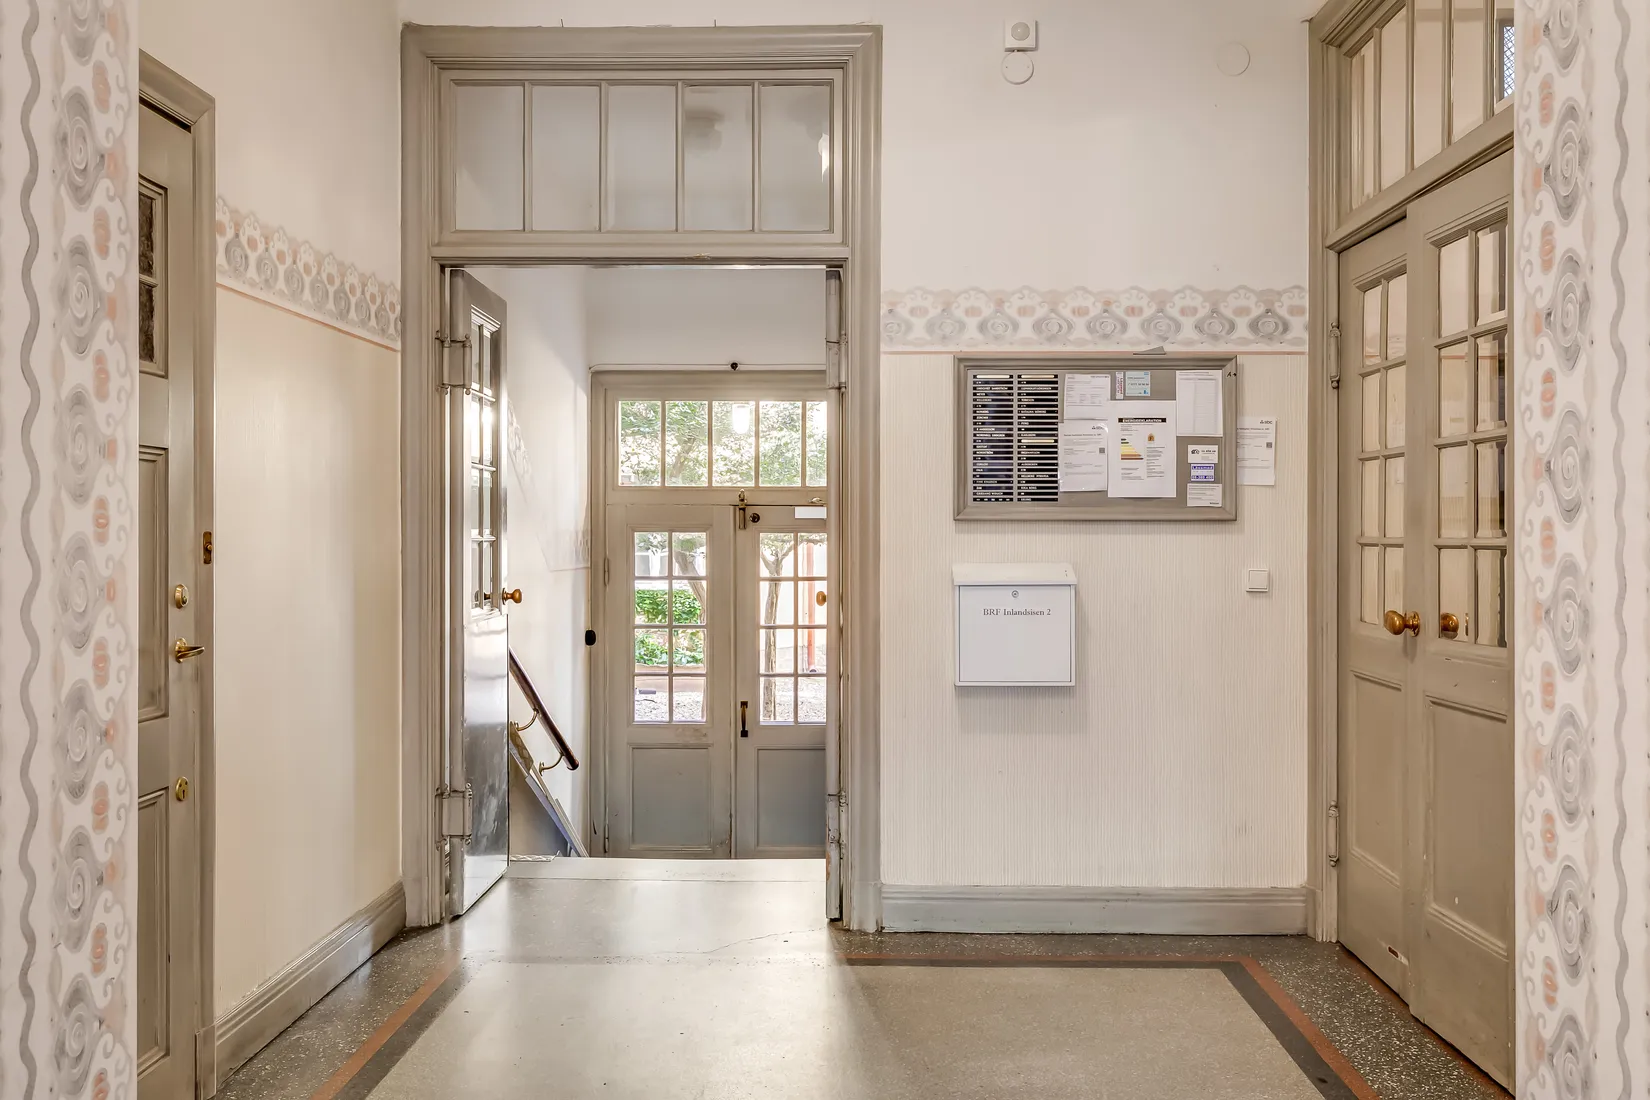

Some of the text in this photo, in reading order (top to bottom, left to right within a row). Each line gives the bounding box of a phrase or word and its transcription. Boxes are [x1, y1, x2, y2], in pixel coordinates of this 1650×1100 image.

[983, 608, 1051, 616] BRF Inlandsisen 2
